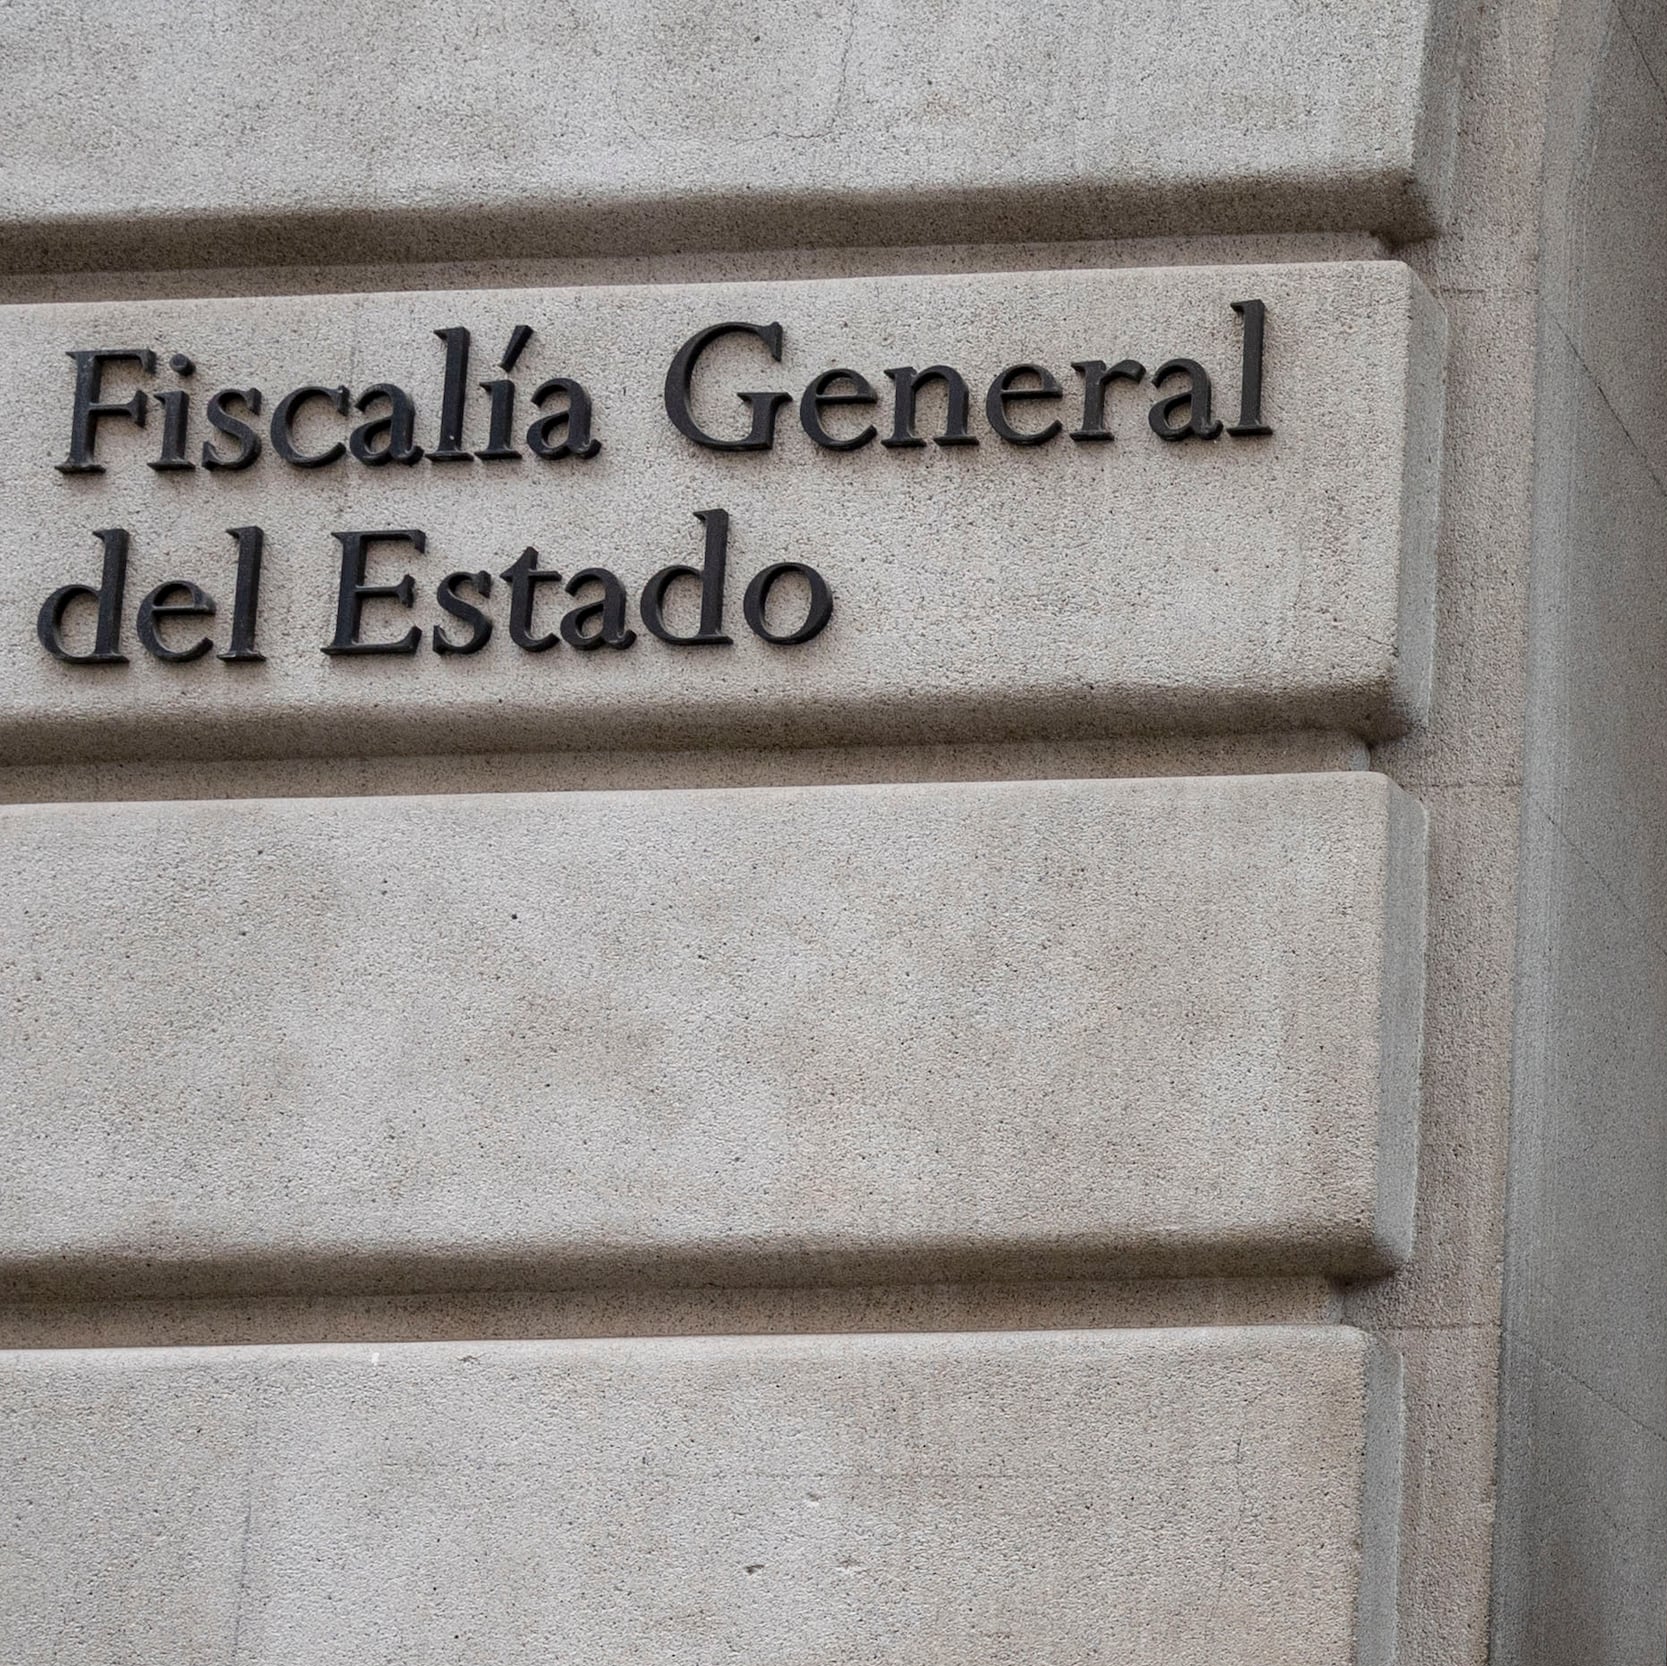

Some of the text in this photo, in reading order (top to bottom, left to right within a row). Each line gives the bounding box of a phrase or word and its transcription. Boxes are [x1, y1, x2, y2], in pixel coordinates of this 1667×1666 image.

[55, 299, 1275, 481] Fiscalía General
[36, 508, 836, 675] del Estado
